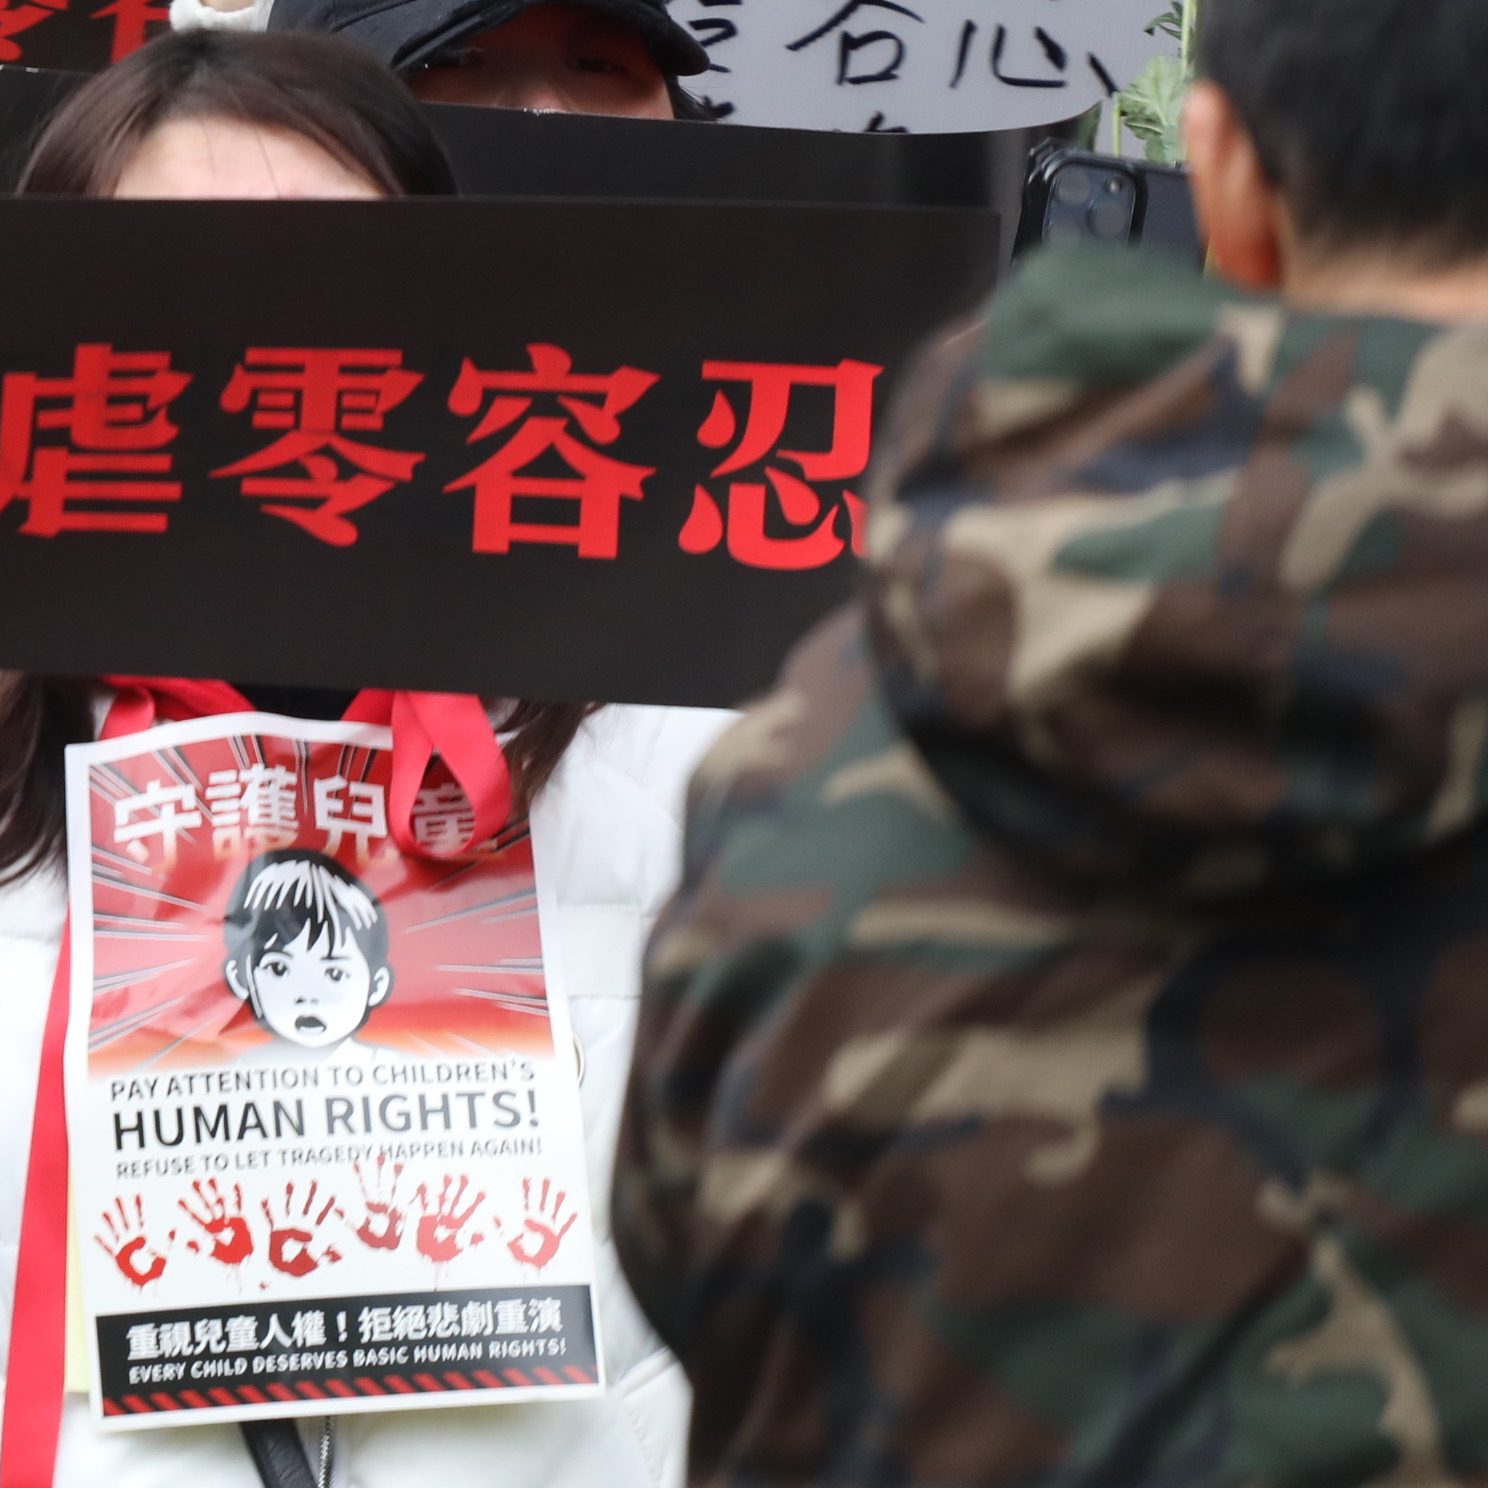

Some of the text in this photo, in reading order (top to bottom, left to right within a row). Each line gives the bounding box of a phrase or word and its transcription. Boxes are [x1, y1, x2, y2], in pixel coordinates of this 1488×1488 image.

[111, 1076, 159, 1102] PAY
[166, 1067, 319, 1098] ATTENTION
[327, 1064, 363, 1086] TO
[113, 1089, 540, 1151] HUMAN RIGHTS!
[116, 1137, 542, 1180] REFUSE TO LET TRAGEDY HAPPEN AGAIN!
[128, 1338, 566, 1385] EVERY CHILD DESERVES BASIC HUMAN RIGHTS!
